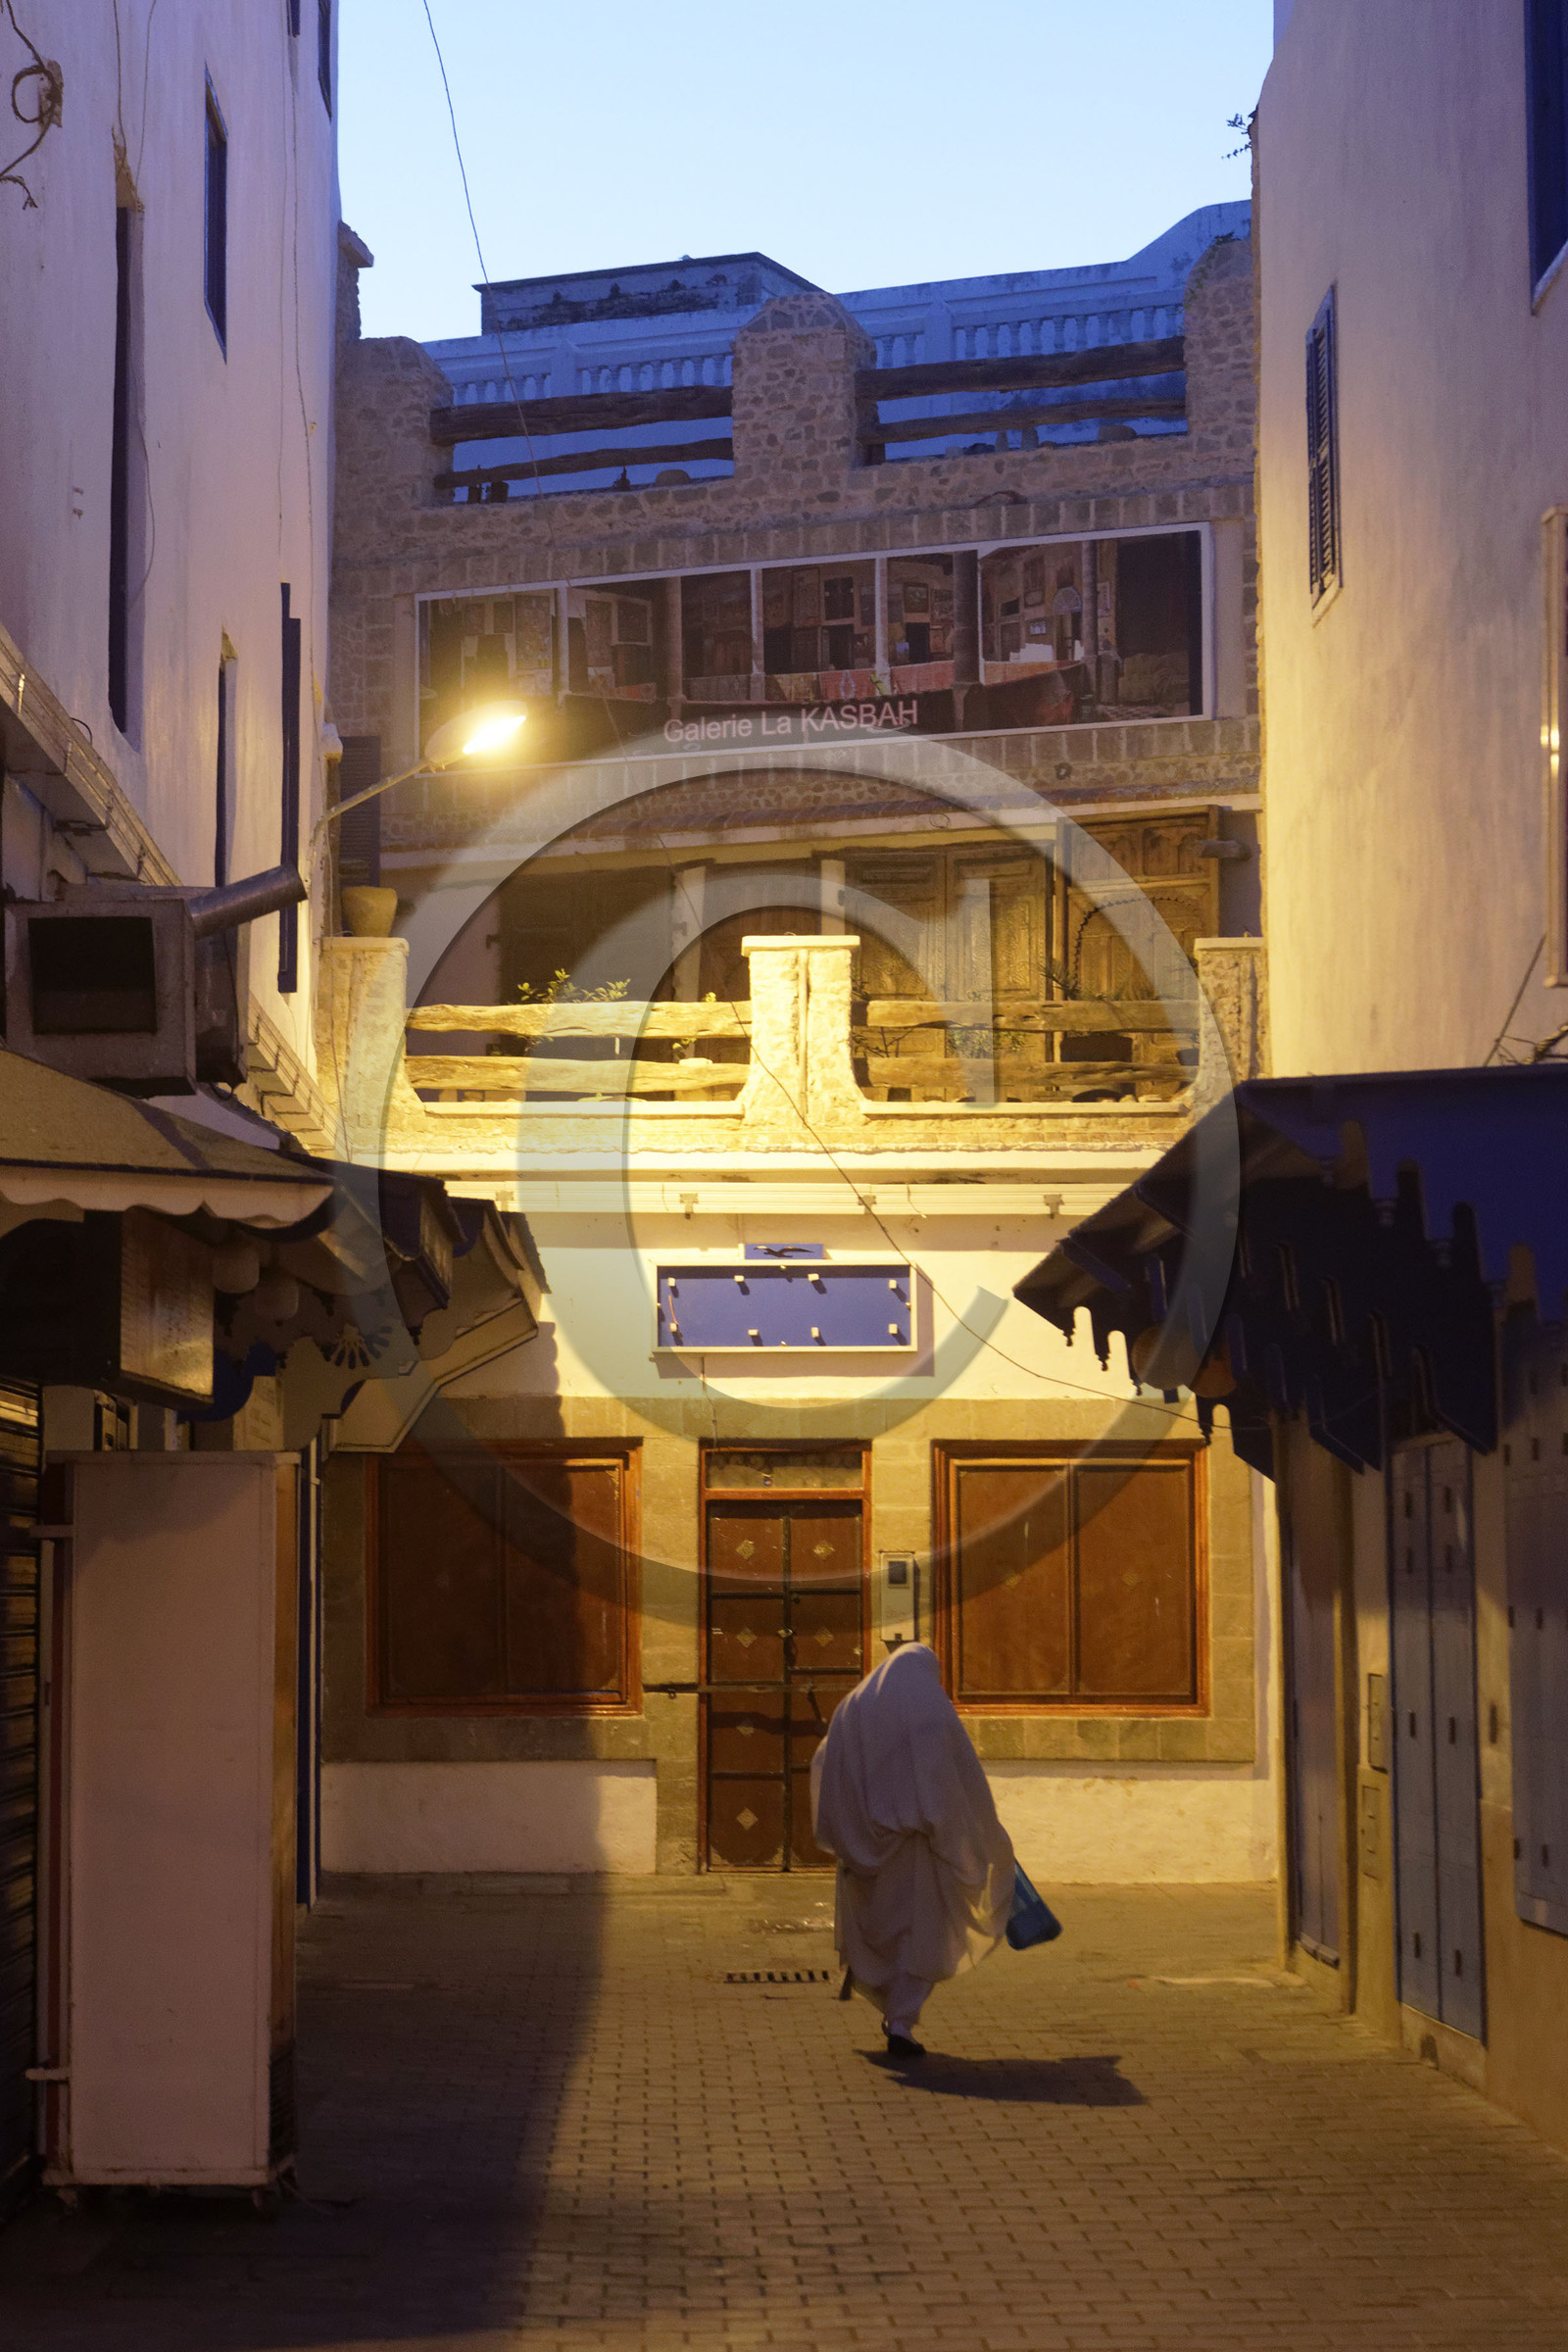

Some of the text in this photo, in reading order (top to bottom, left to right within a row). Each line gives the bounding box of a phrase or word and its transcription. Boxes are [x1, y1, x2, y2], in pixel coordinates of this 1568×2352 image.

[663, 699, 918, 743] Galerie La KASBAH
